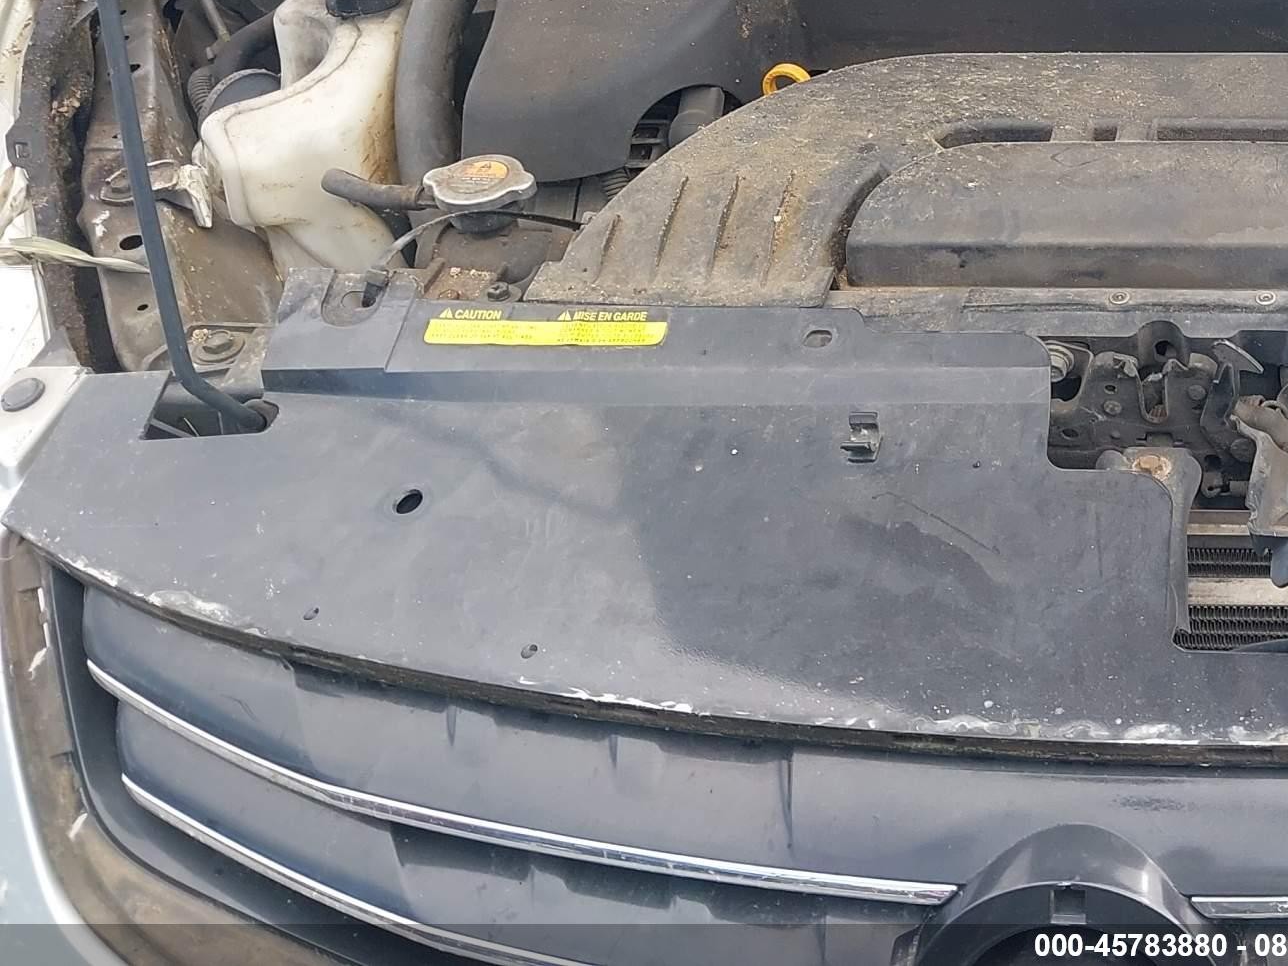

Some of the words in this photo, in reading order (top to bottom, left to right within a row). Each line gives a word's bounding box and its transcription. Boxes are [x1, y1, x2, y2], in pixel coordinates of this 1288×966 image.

[454, 309, 502, 320] CAUTION
[572, 310, 598, 321] MISE
[598, 311, 613, 321] EN
[613, 311, 648, 321] GARDE
